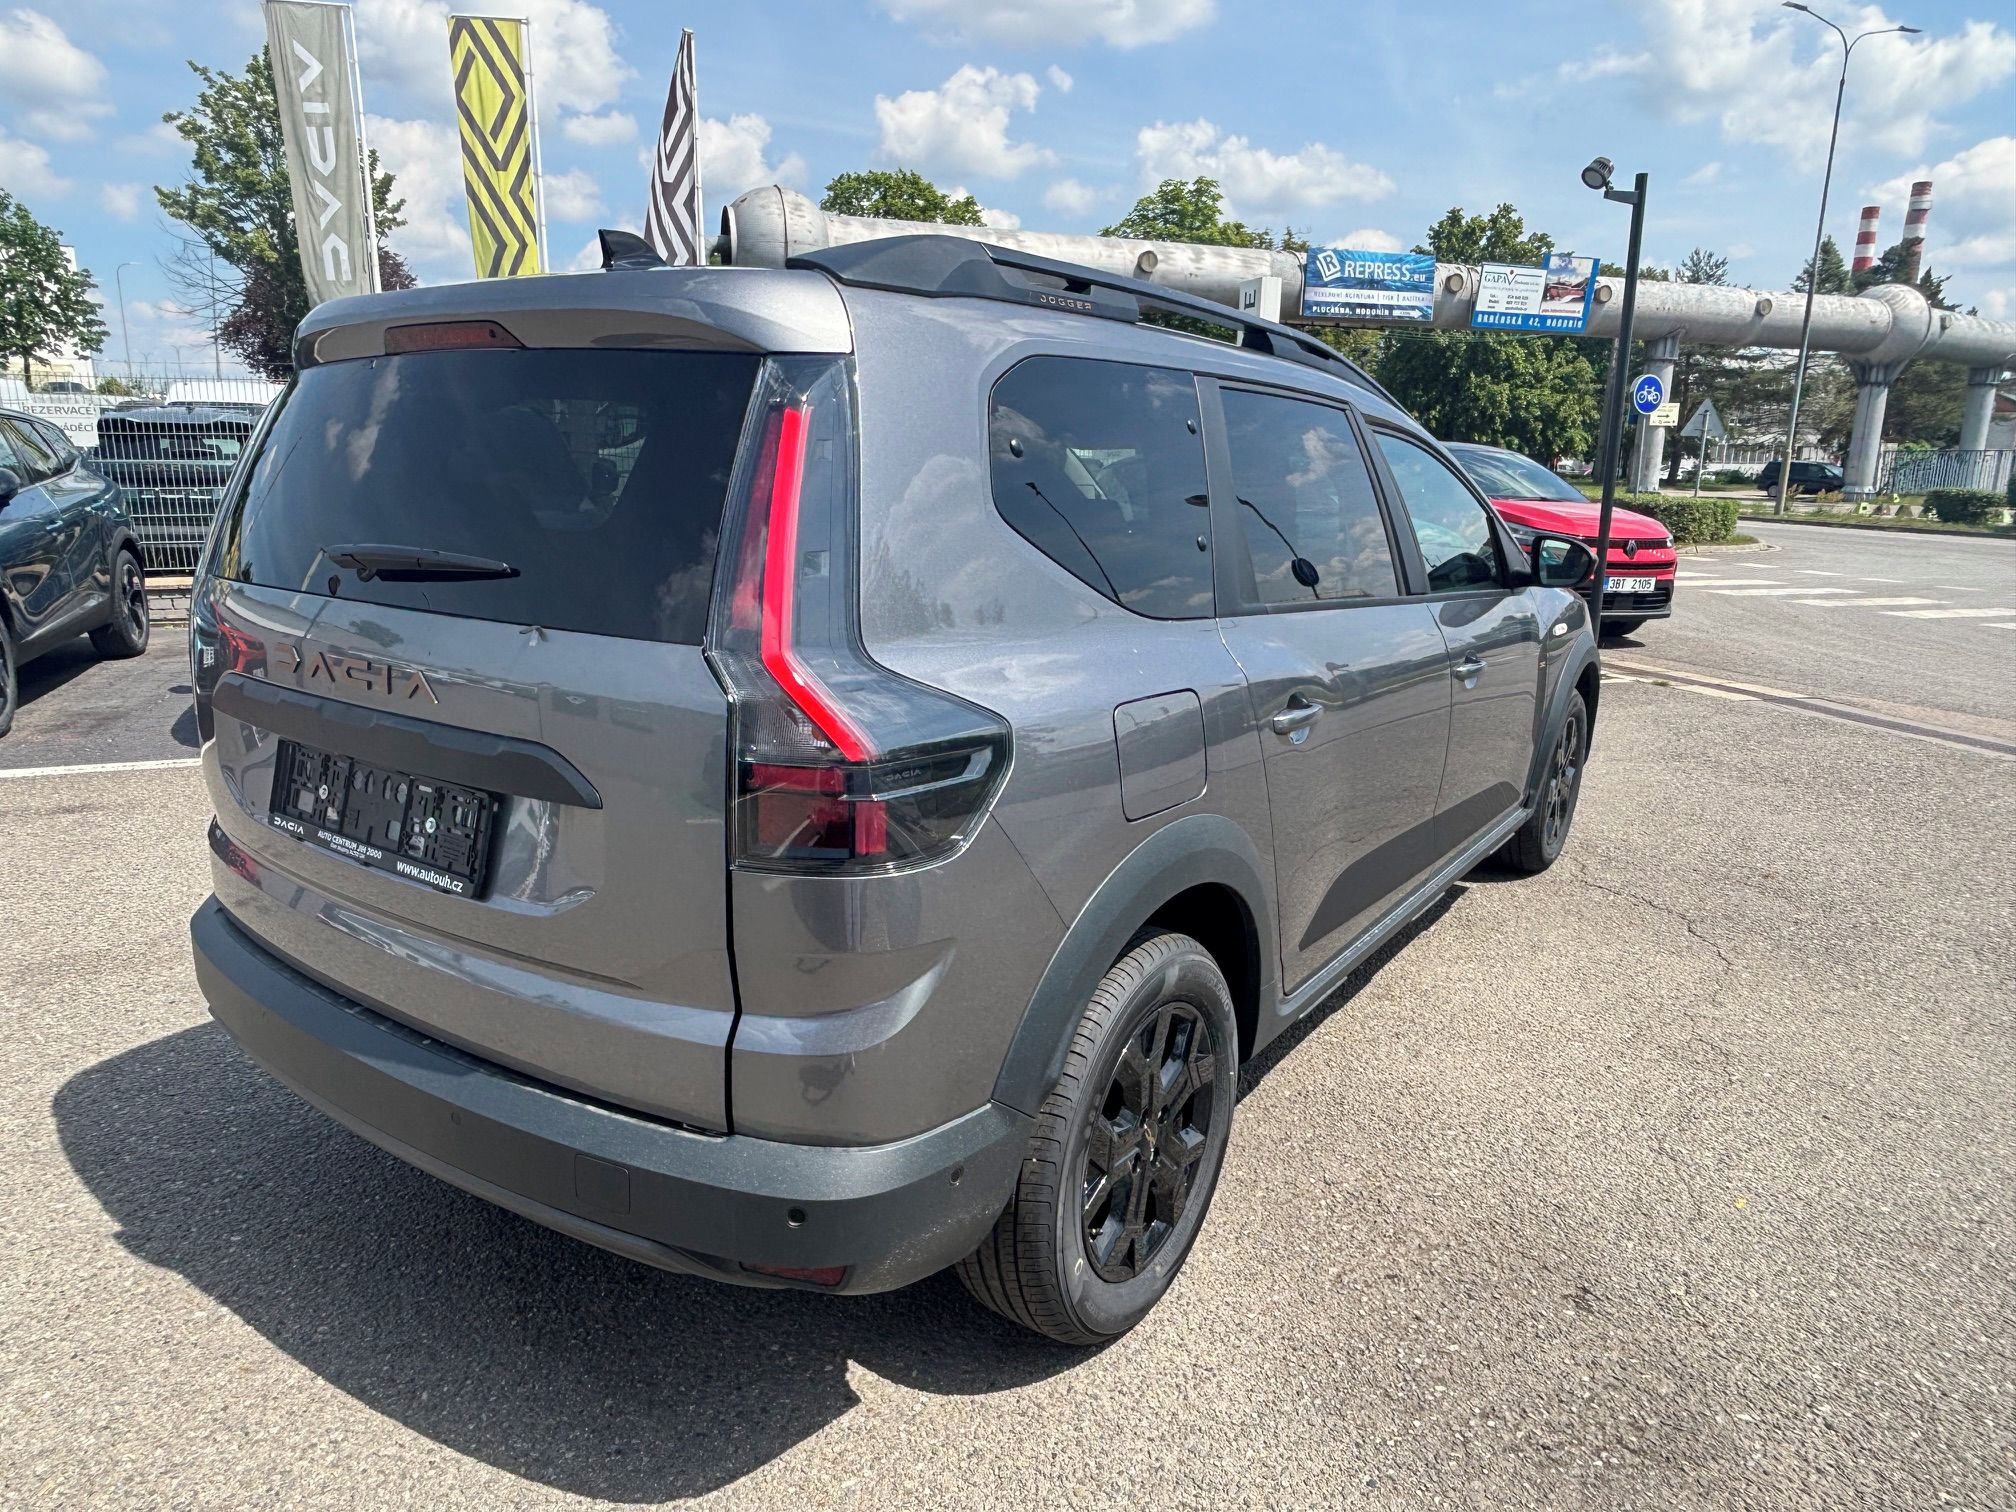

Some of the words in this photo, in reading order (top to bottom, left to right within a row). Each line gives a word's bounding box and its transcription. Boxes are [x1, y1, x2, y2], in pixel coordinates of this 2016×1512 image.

[292, 38, 352, 281] DACIA
[1040, 294, 1092, 311] JOGGER
[61, 422, 94, 432] ÁDĚCÍ
[1609, 579, 1627, 590] 3BT
[1631, 579, 1652, 590] 2105
[276, 642, 439, 704] DACIA
[274, 816, 304, 835] DACIA
[317, 830, 332, 842] AUTO
[331, 835, 358, 850] CENTRUM
[366, 847, 382, 860] 2000
[396, 860, 464, 893] www.autouh.cz
